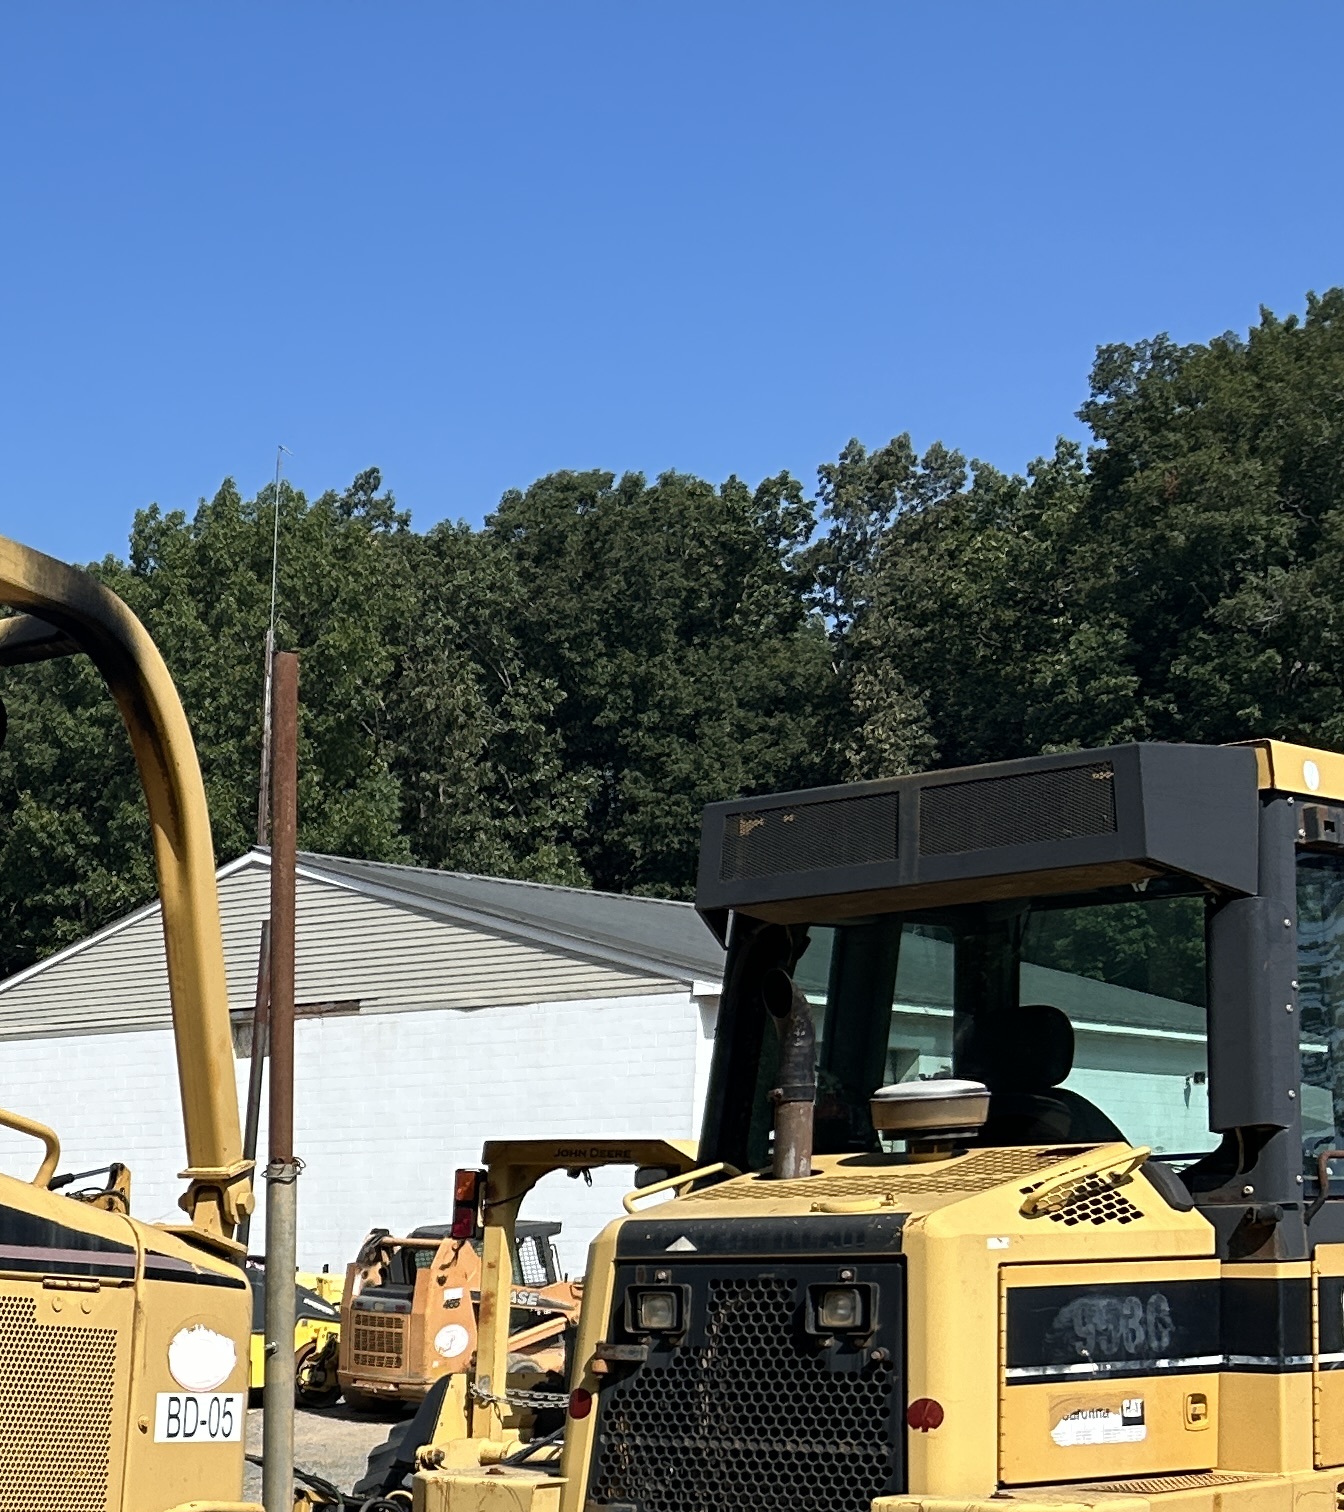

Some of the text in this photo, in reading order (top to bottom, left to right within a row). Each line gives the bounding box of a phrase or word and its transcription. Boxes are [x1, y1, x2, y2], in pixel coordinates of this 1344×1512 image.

[554, 1147, 632, 1158] JOHN DEERE
[166, 1396, 234, 1438] BD-05
